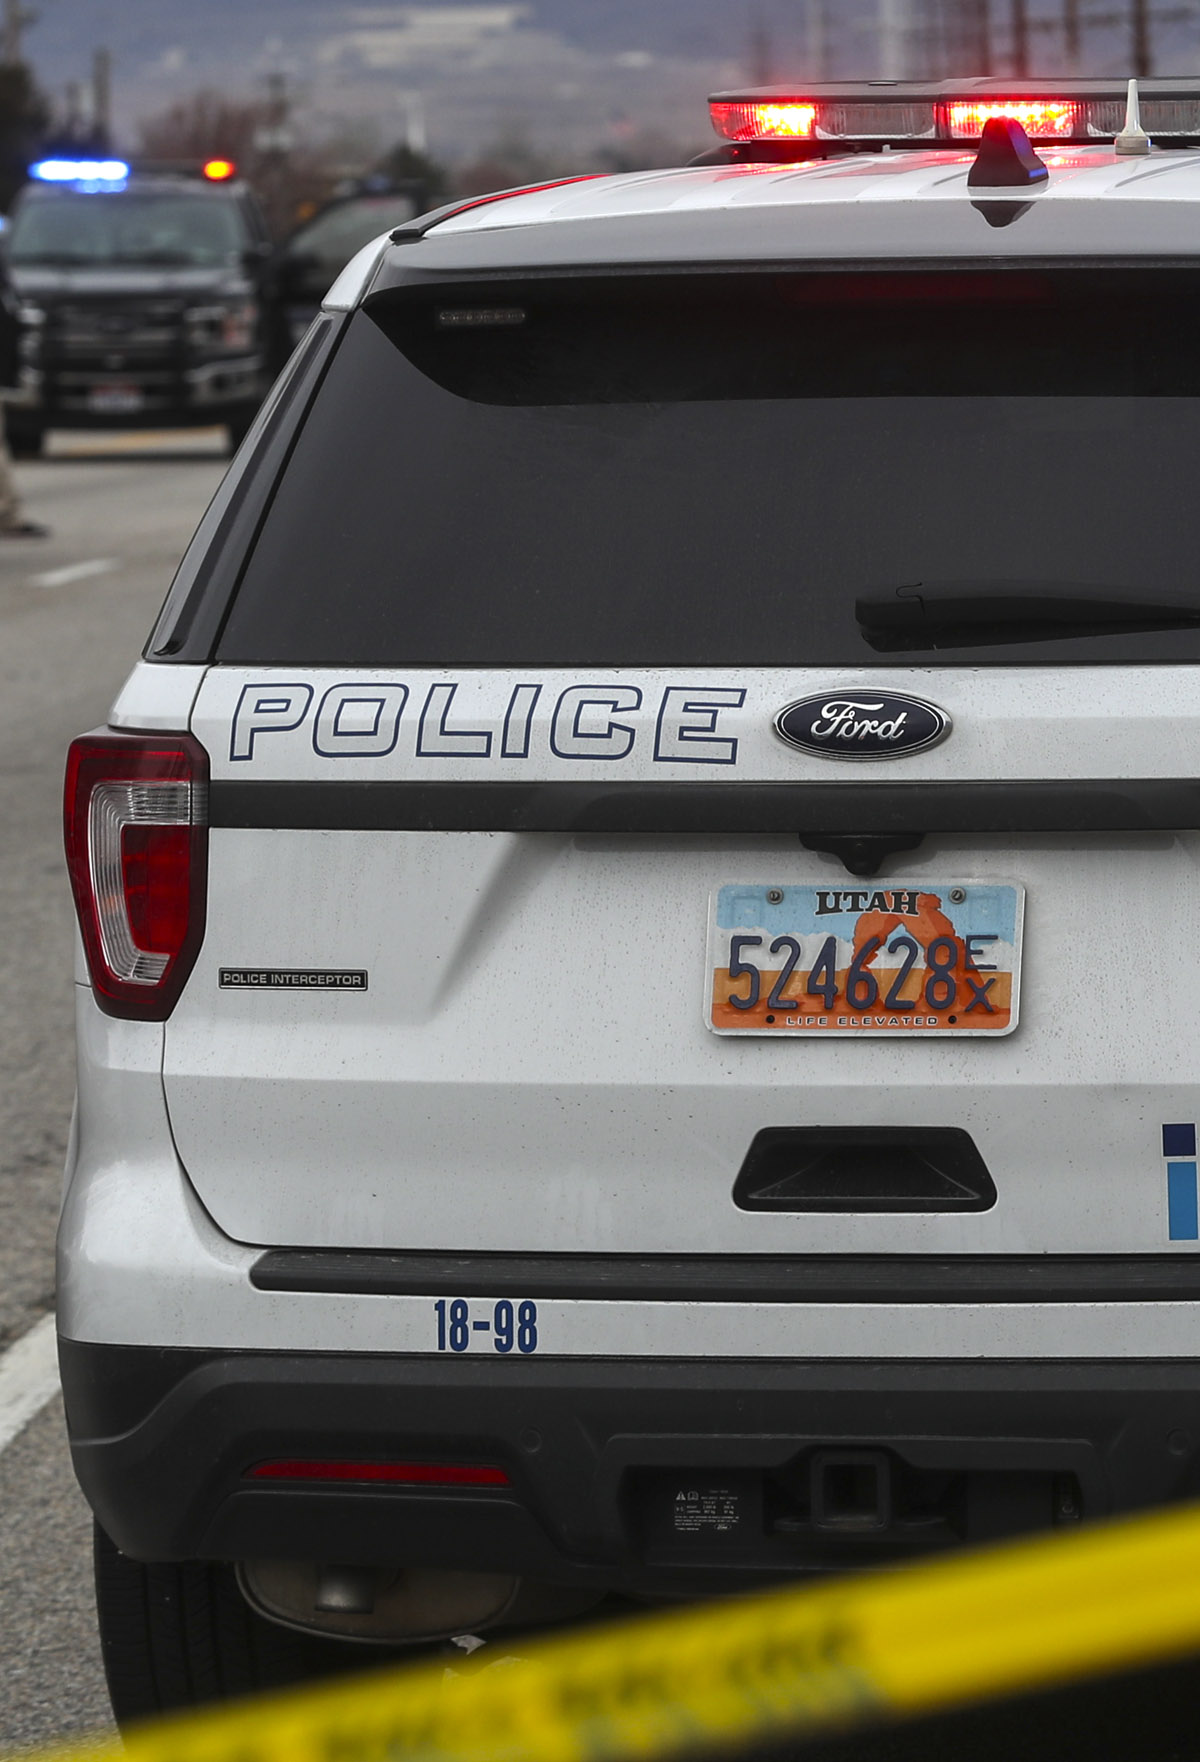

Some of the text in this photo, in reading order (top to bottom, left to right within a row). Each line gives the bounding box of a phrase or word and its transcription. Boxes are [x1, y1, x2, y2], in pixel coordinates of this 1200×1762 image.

[230, 682, 747, 765] POLICE
[811, 700, 908, 741] Ford
[815, 890, 919, 916] UTAH
[223, 973, 362, 985] POLICE INTERCEPTOR
[728, 934, 959, 1012] 524628
[786, 1016, 938, 1025] LIFE ELEVATED
[434, 1299, 538, 1354] 18-98
